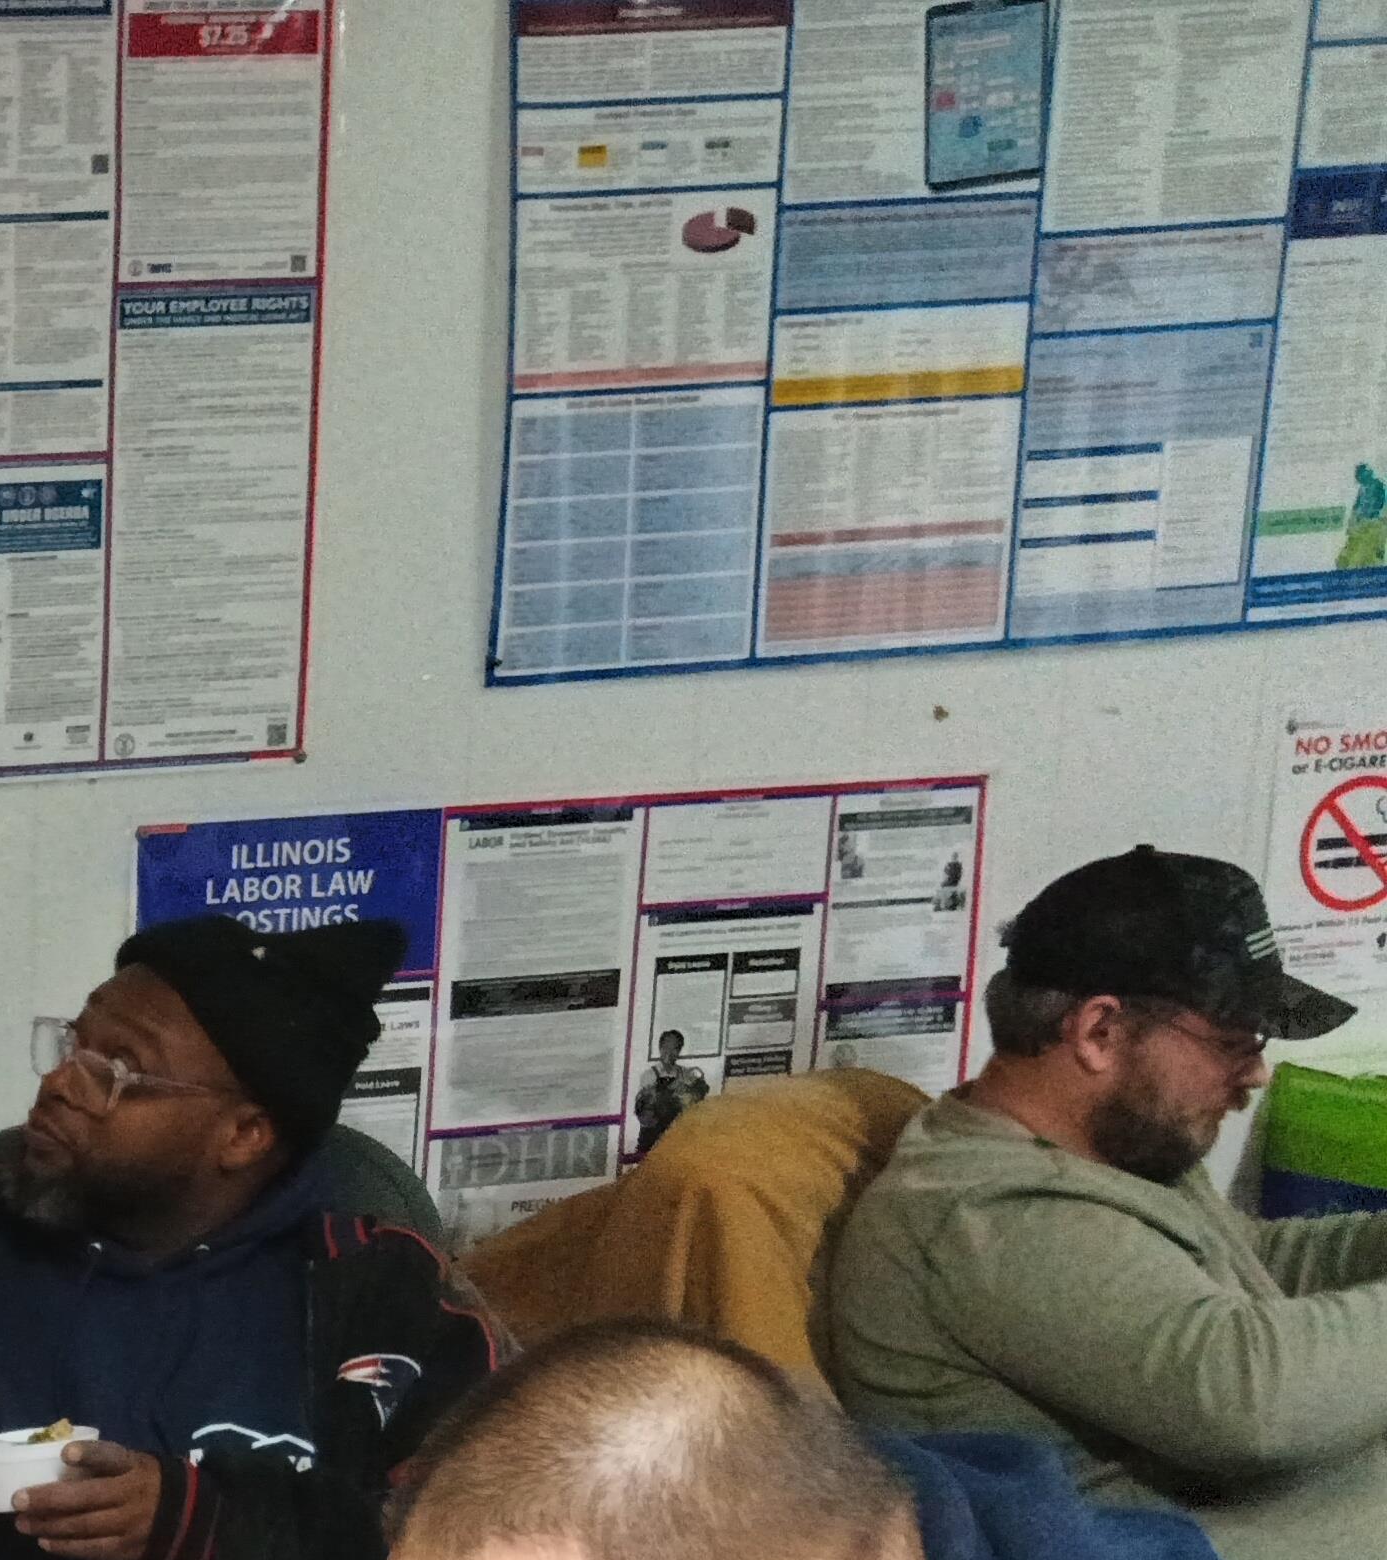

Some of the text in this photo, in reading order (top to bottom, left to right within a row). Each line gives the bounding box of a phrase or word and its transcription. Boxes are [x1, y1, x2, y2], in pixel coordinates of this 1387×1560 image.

[124, 295, 308, 314] YOUR EMPLOYEE RIGHTS
[1294, 735, 1331, 756] NO
[1292, 764, 1309, 775] or
[469, 836, 504, 849] LABOR
[231, 837, 351, 870] ILLINOIS
[205, 869, 375, 905] LABOR LAW
[230, 903, 359, 934] OSTINGS
